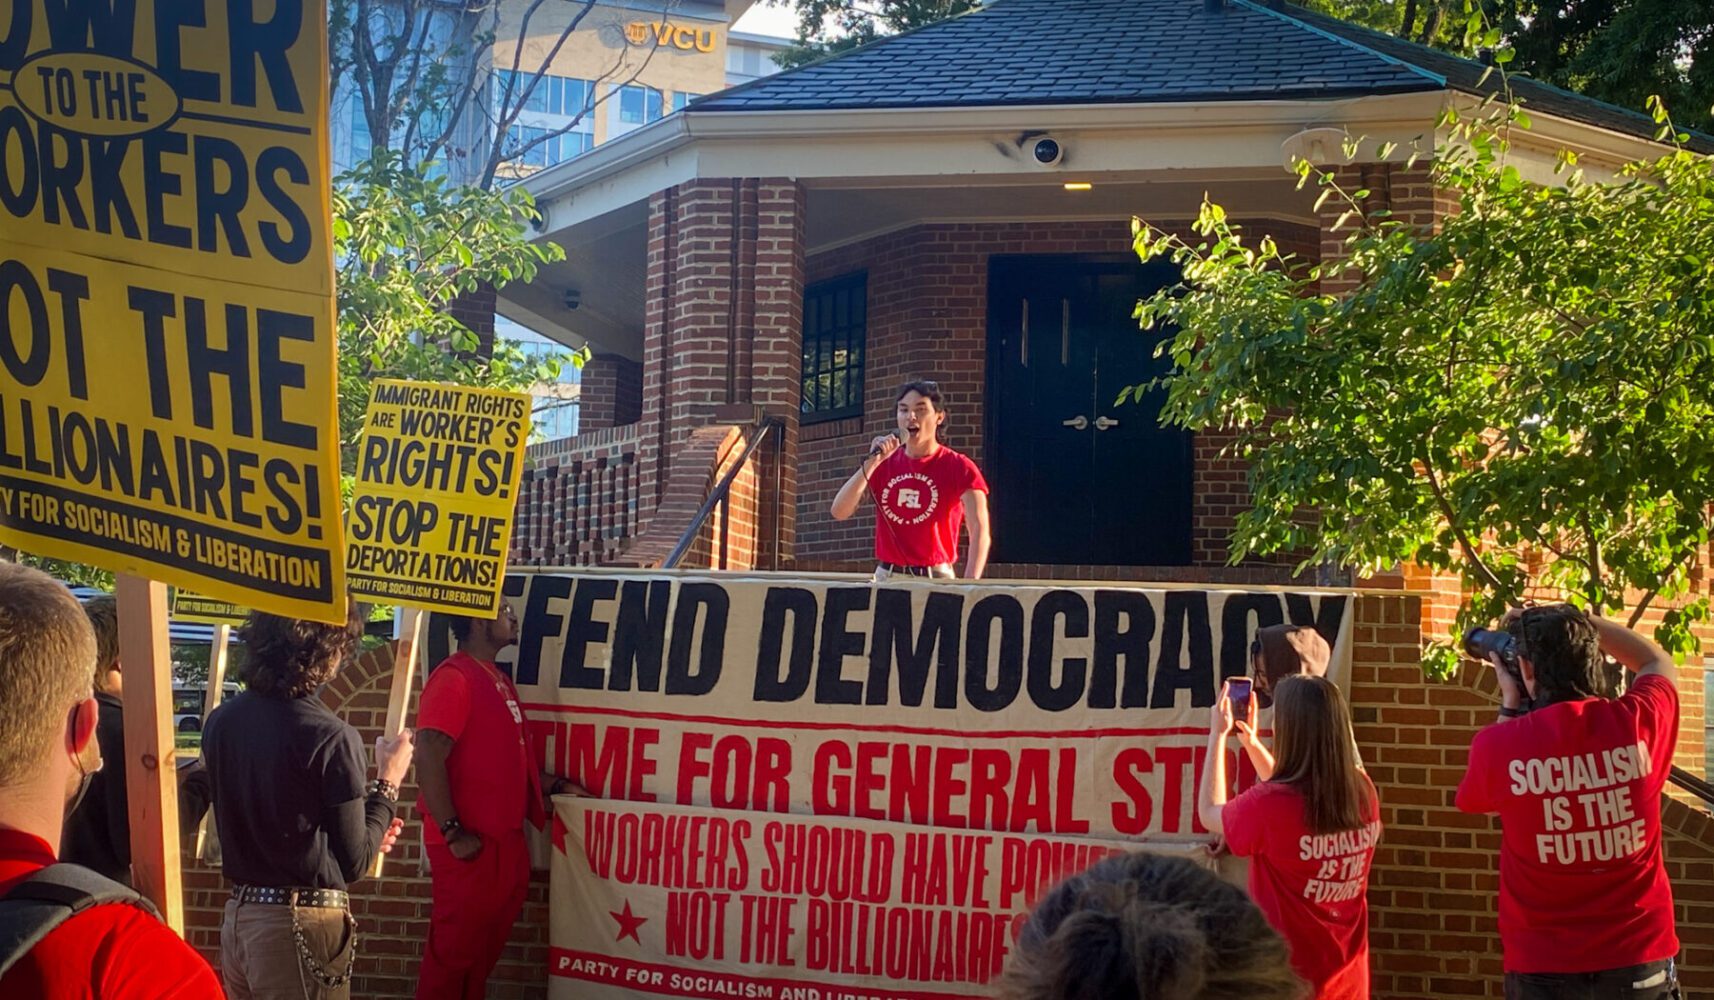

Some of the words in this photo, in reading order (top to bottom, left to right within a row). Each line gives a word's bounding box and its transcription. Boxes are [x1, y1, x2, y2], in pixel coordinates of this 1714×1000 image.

[651, 22, 717, 53] VCU
[37, 66, 77, 117] TO
[83, 70, 149, 122] THE
[127, 285, 318, 450] THE
[374, 384, 462, 412] IMMIGRANT
[466, 393, 525, 419] RIGHTS
[371, 411, 396, 428] ARE
[400, 408, 521, 448] WORKER'S
[361, 435, 514, 499] RIGHTS!
[887, 472, 928, 488] SOCIALISM
[881, 488, 890, 504] FOR
[882, 505, 904, 525] PARTY
[912, 485, 939, 524] LIBERATION
[19, 491, 60, 526] FOR
[64, 500, 172, 554] SOCIALISM
[176, 529, 191, 559] &
[195, 537, 321, 589] LIBERATION
[352, 495, 439, 547] STOP
[447, 512, 506, 556] THE
[347, 544, 498, 587] DEPORTATIONS!
[347, 577, 371, 591] PARTY
[372, 581, 387, 592] FOR
[388, 582, 431, 598] SOCIALISM
[433, 588, 440, 599] &
[441, 590, 491, 606] LIBERATION
[427, 574, 731, 696] FEND
[527, 719, 659, 803] TIME
[676, 731, 793, 813] FOR
[812, 739, 1091, 834] GENERAL
[1509, 740, 1653, 796] SOCIALISM
[1543, 796, 1573, 831] IS
[1578, 786, 1635, 827] THE
[584, 809, 751, 891] WORKERS
[761, 820, 895, 904] SHOULD
[901, 832, 993, 908] HAVE
[1536, 818, 1646, 865] FUTURE
[1317, 859, 1339, 879] IS
[1340, 852, 1367, 880] THE
[1303, 876, 1364, 904] FUTURE
[666, 891, 730, 961] NOT
[740, 895, 797, 966] THE
[559, 956, 619, 978] PARTY
[626, 968, 664, 985] FOR
[670, 973, 773, 998] SOCIALISM
[780, 986, 821, 1000] AND
